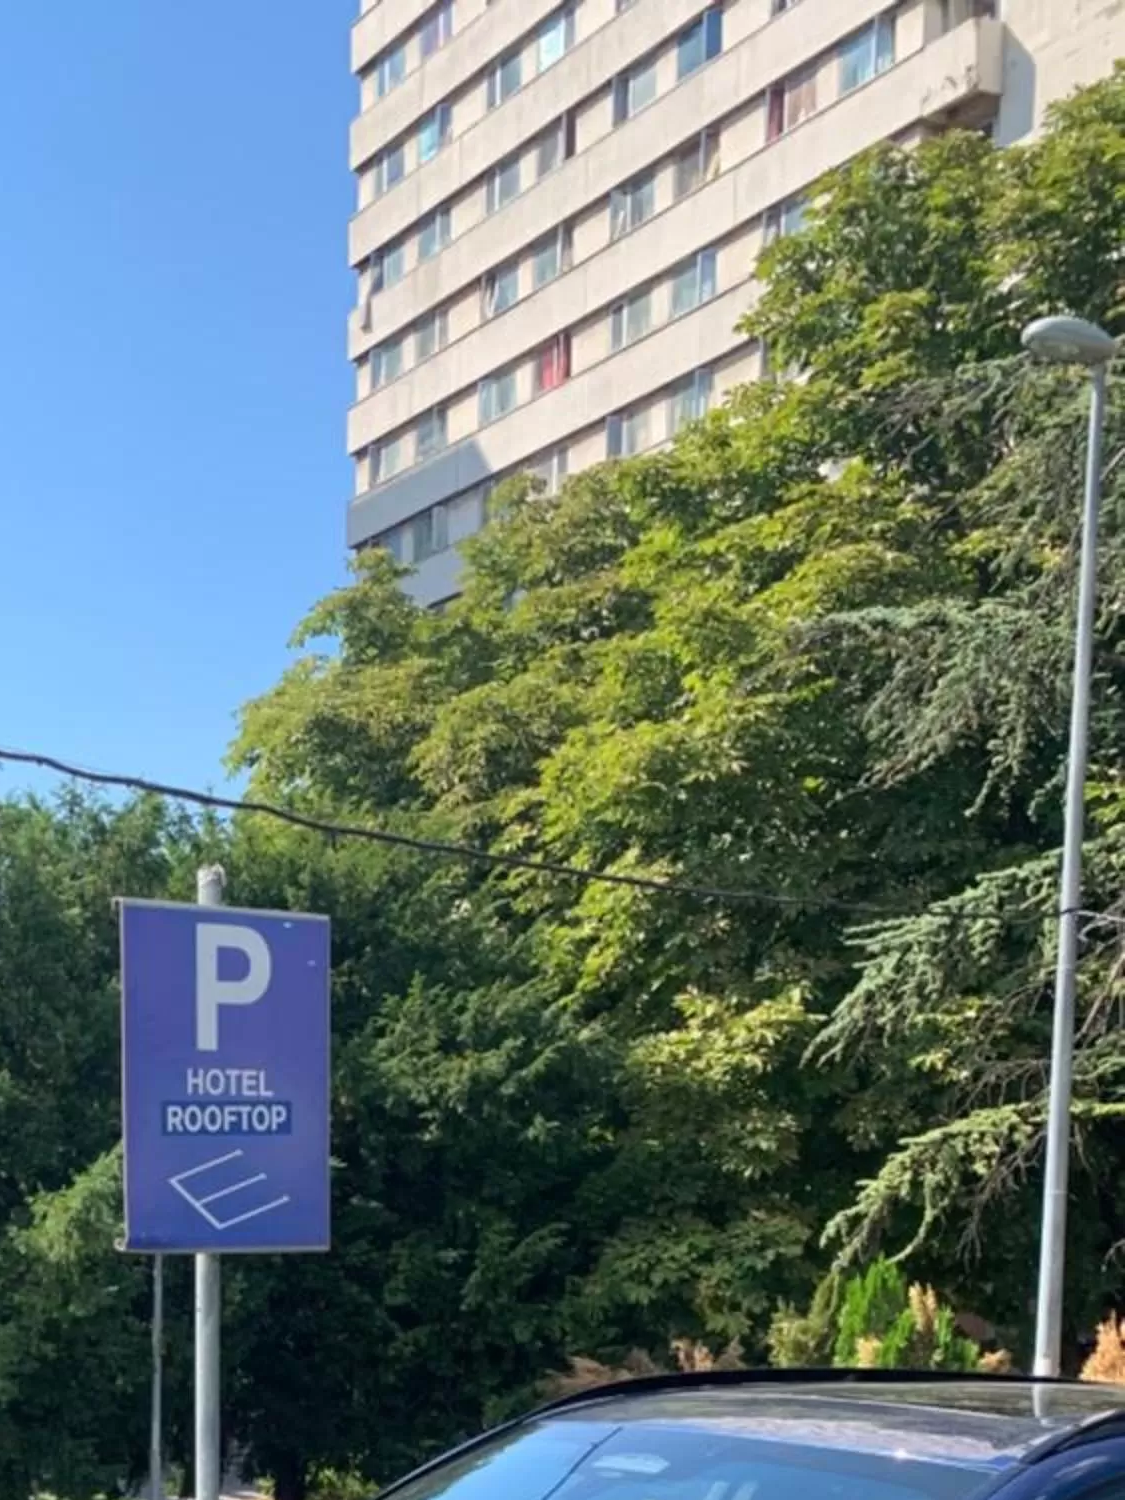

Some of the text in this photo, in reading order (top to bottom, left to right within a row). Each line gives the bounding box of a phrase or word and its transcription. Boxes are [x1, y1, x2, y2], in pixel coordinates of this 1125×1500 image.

[195, 922, 272, 1051] P
[186, 1068, 275, 1097] HOTEL
[166, 1104, 288, 1133] ROOFTOP
